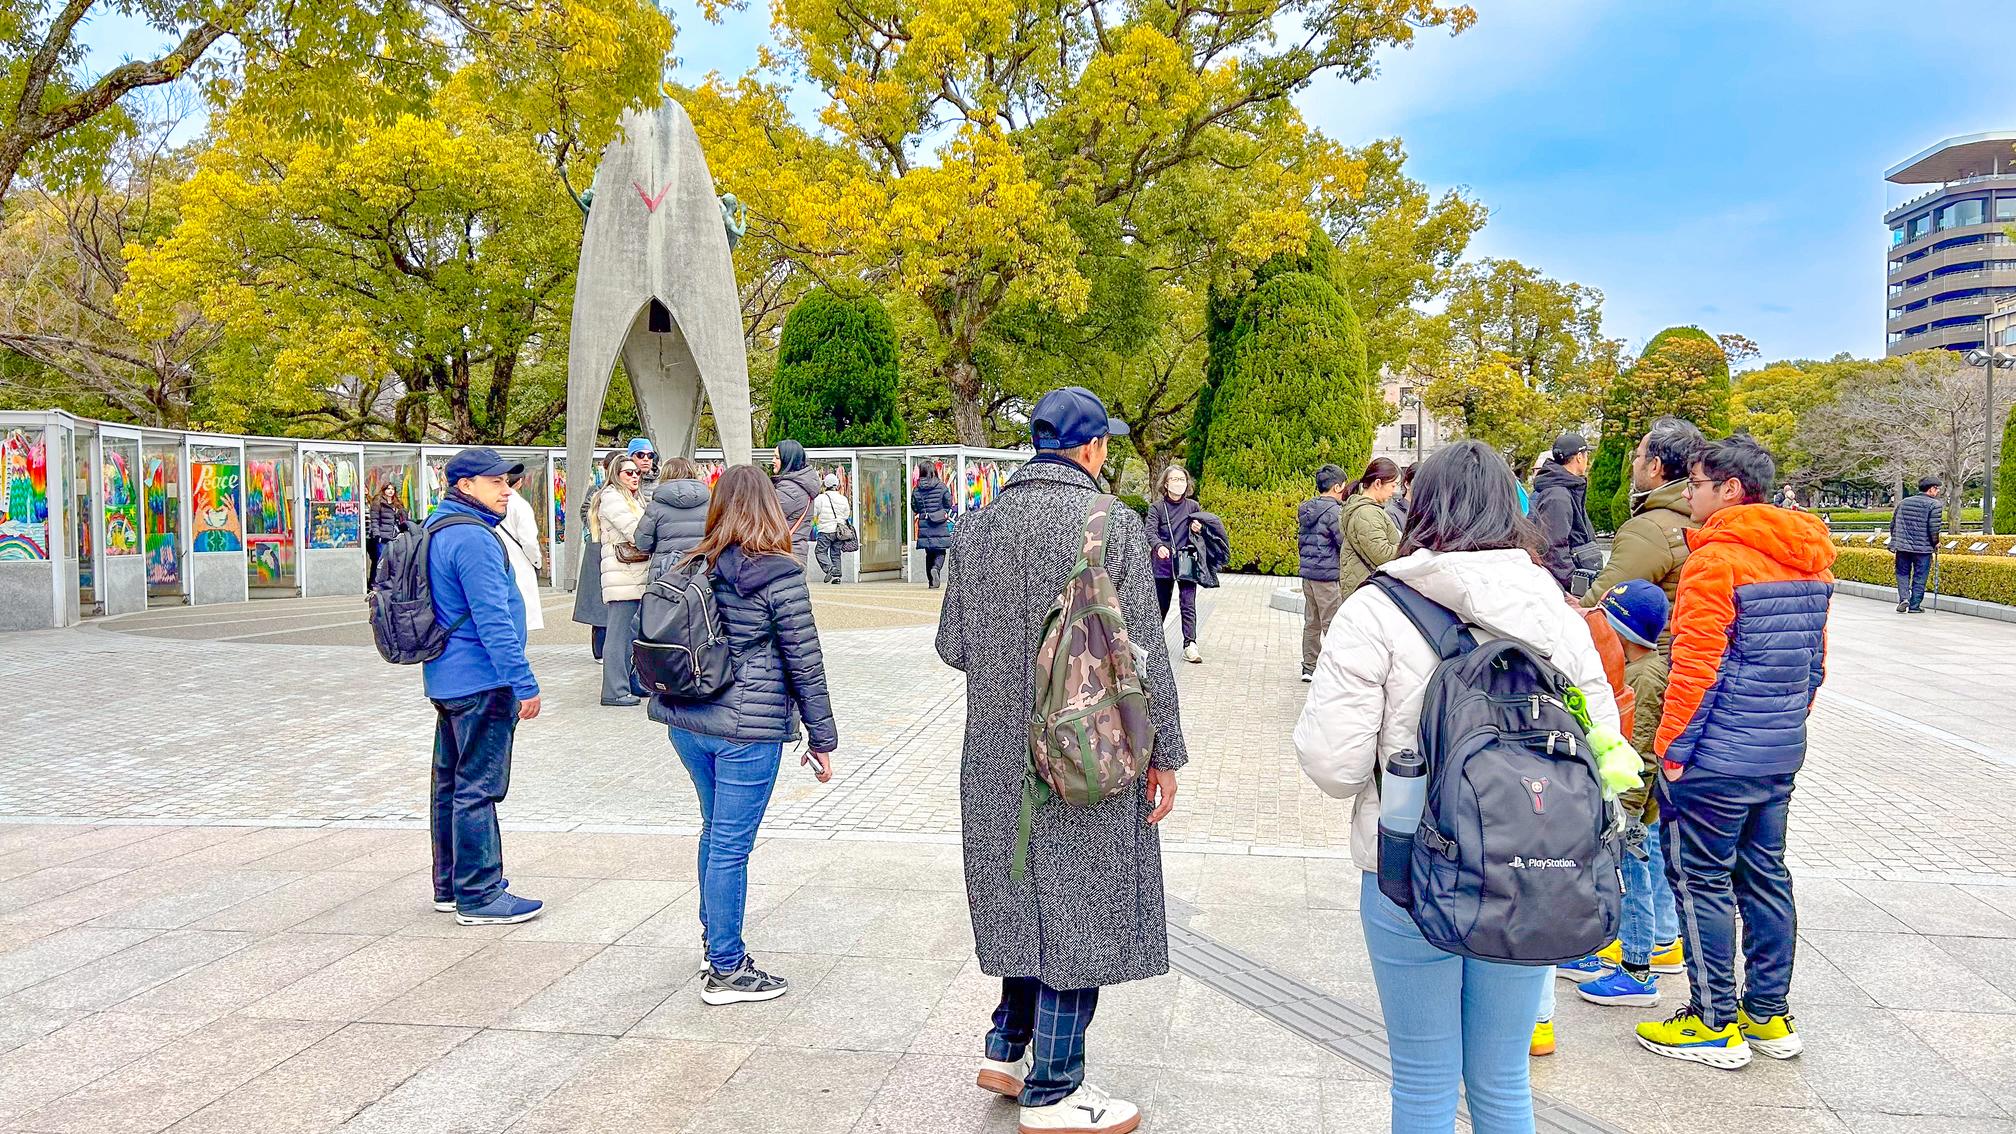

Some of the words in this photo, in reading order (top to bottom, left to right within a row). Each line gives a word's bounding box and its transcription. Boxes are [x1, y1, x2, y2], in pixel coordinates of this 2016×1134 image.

[194, 465, 239, 496] Peace
[335, 502, 358, 515] 2024
[1528, 858, 1576, 870] PlayStation
